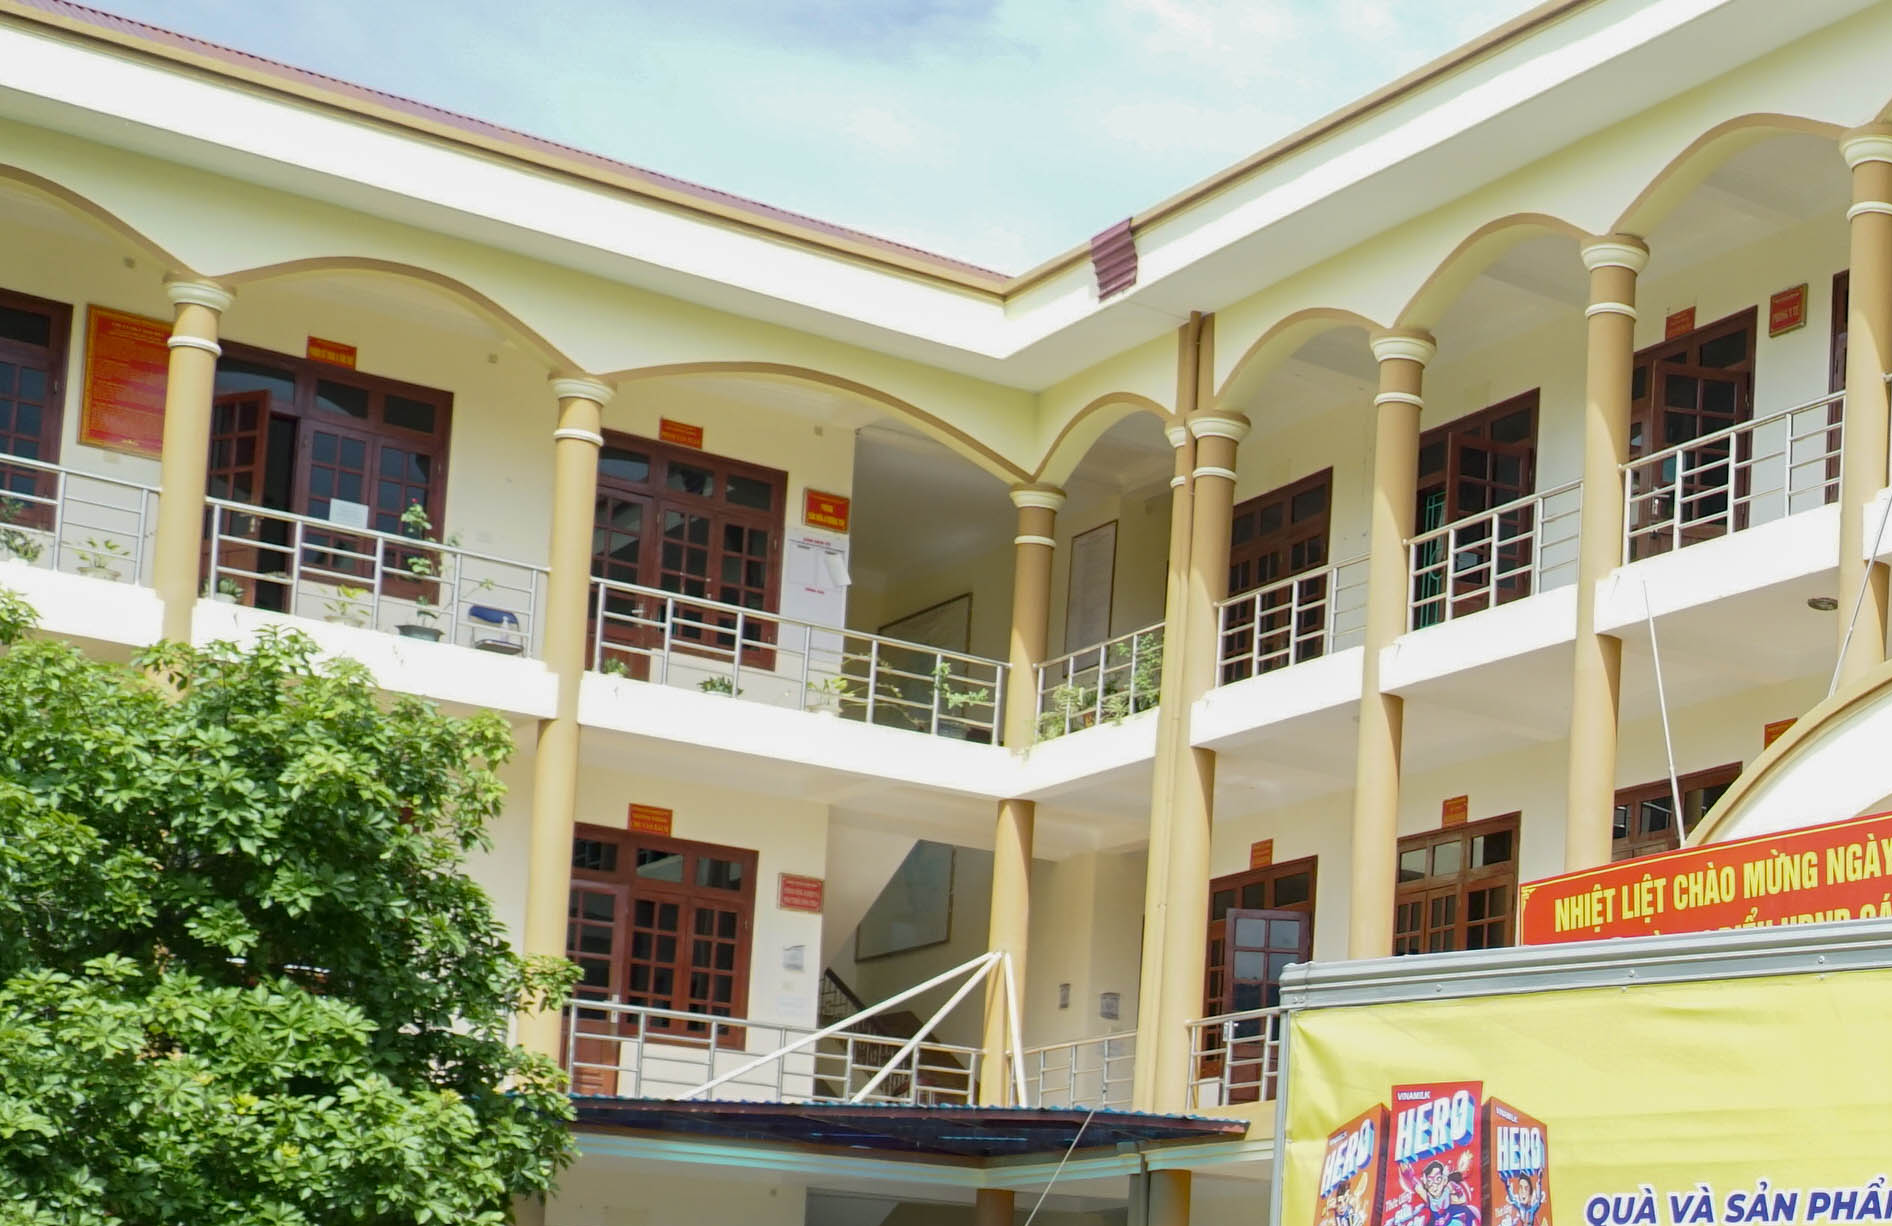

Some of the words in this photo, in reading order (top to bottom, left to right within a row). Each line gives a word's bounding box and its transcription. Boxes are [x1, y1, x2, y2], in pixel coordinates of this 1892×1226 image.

[1554, 883, 1617, 933] NHIỆT
[1621, 874, 1667, 923] LIỆT
[1673, 862, 1736, 912] CHÀO
[1743, 849, 1818, 899] MỪNG
[1670, 1186, 1715, 1223] VÀ
[1726, 1180, 1797, 1222] SẢN
